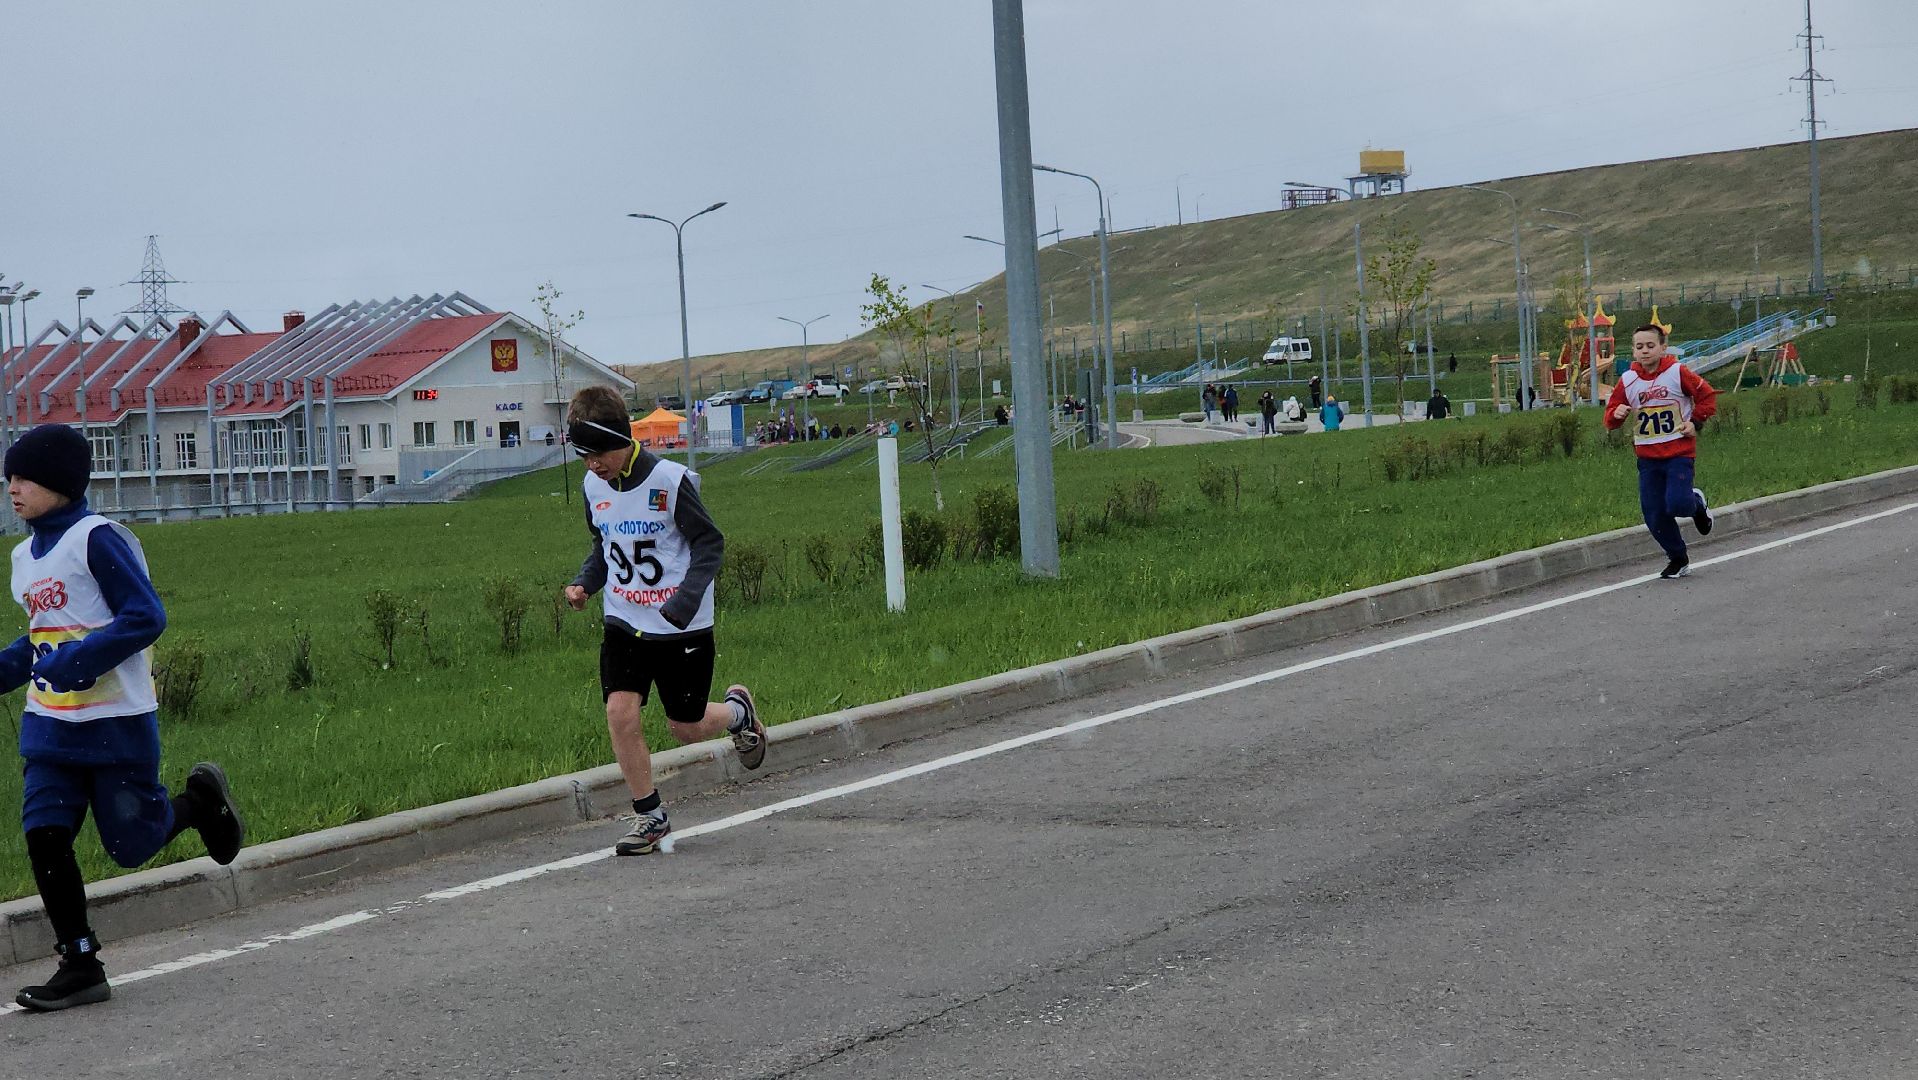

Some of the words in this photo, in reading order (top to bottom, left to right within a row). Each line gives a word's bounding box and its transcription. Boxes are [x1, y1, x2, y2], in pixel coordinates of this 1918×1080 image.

[495, 402, 524, 411] КАФЕ
[1638, 410, 1675, 435] 213
[610, 539, 663, 586] 95
